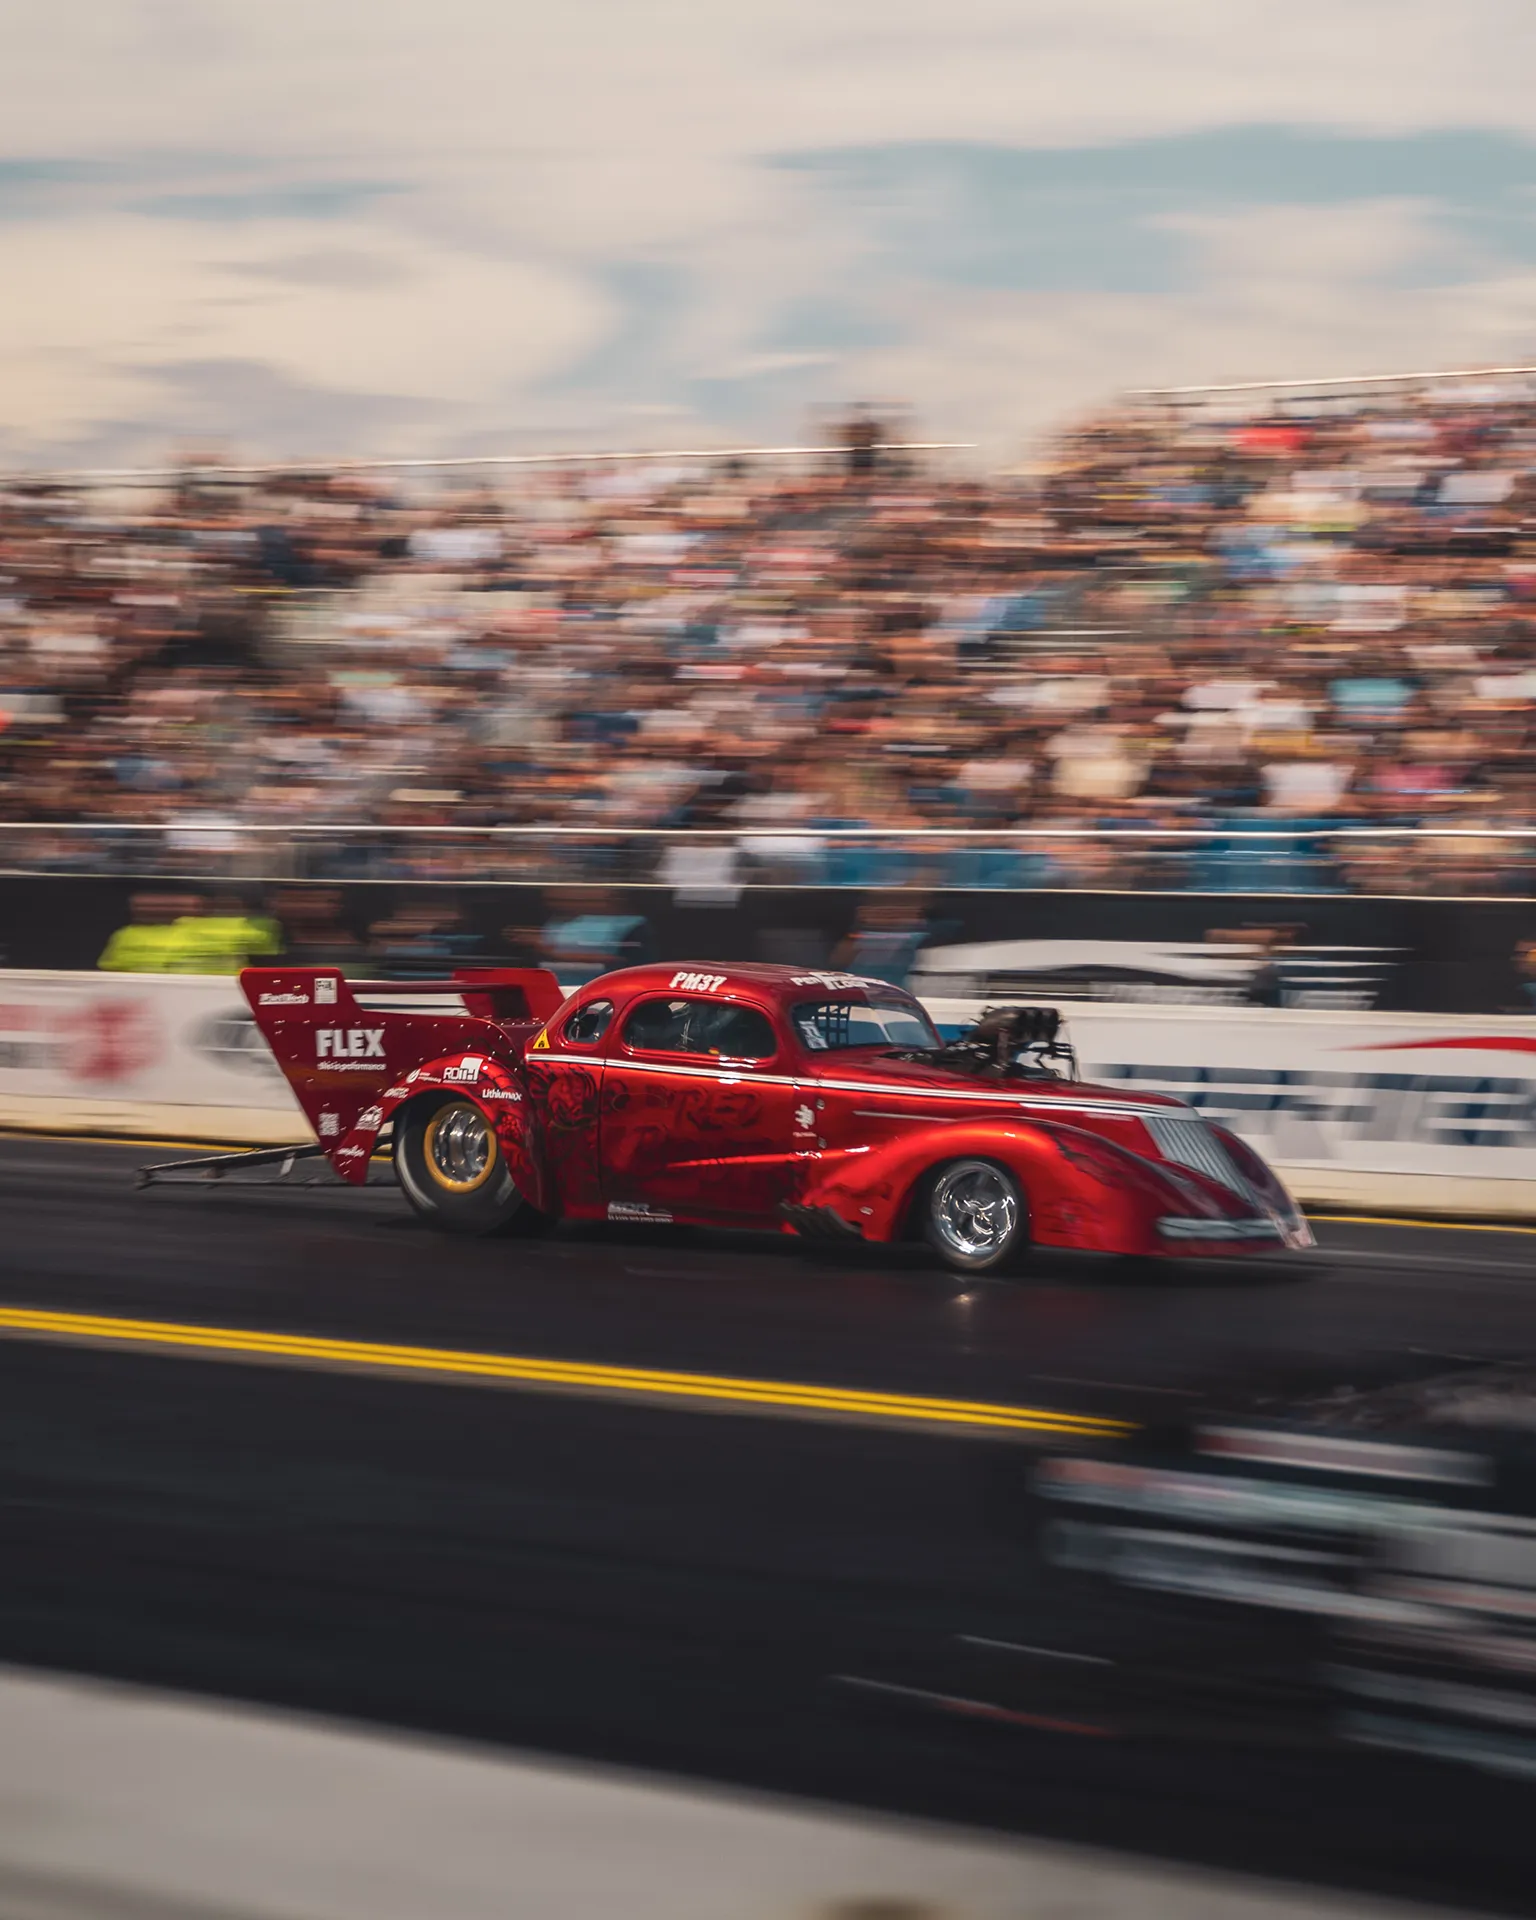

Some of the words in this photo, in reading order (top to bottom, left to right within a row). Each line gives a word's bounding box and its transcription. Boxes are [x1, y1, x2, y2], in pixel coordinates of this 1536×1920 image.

[669, 971, 728, 992] PM37
[315, 1029, 386, 1057] FLEX
[443, 1066, 481, 1081] ROTH
